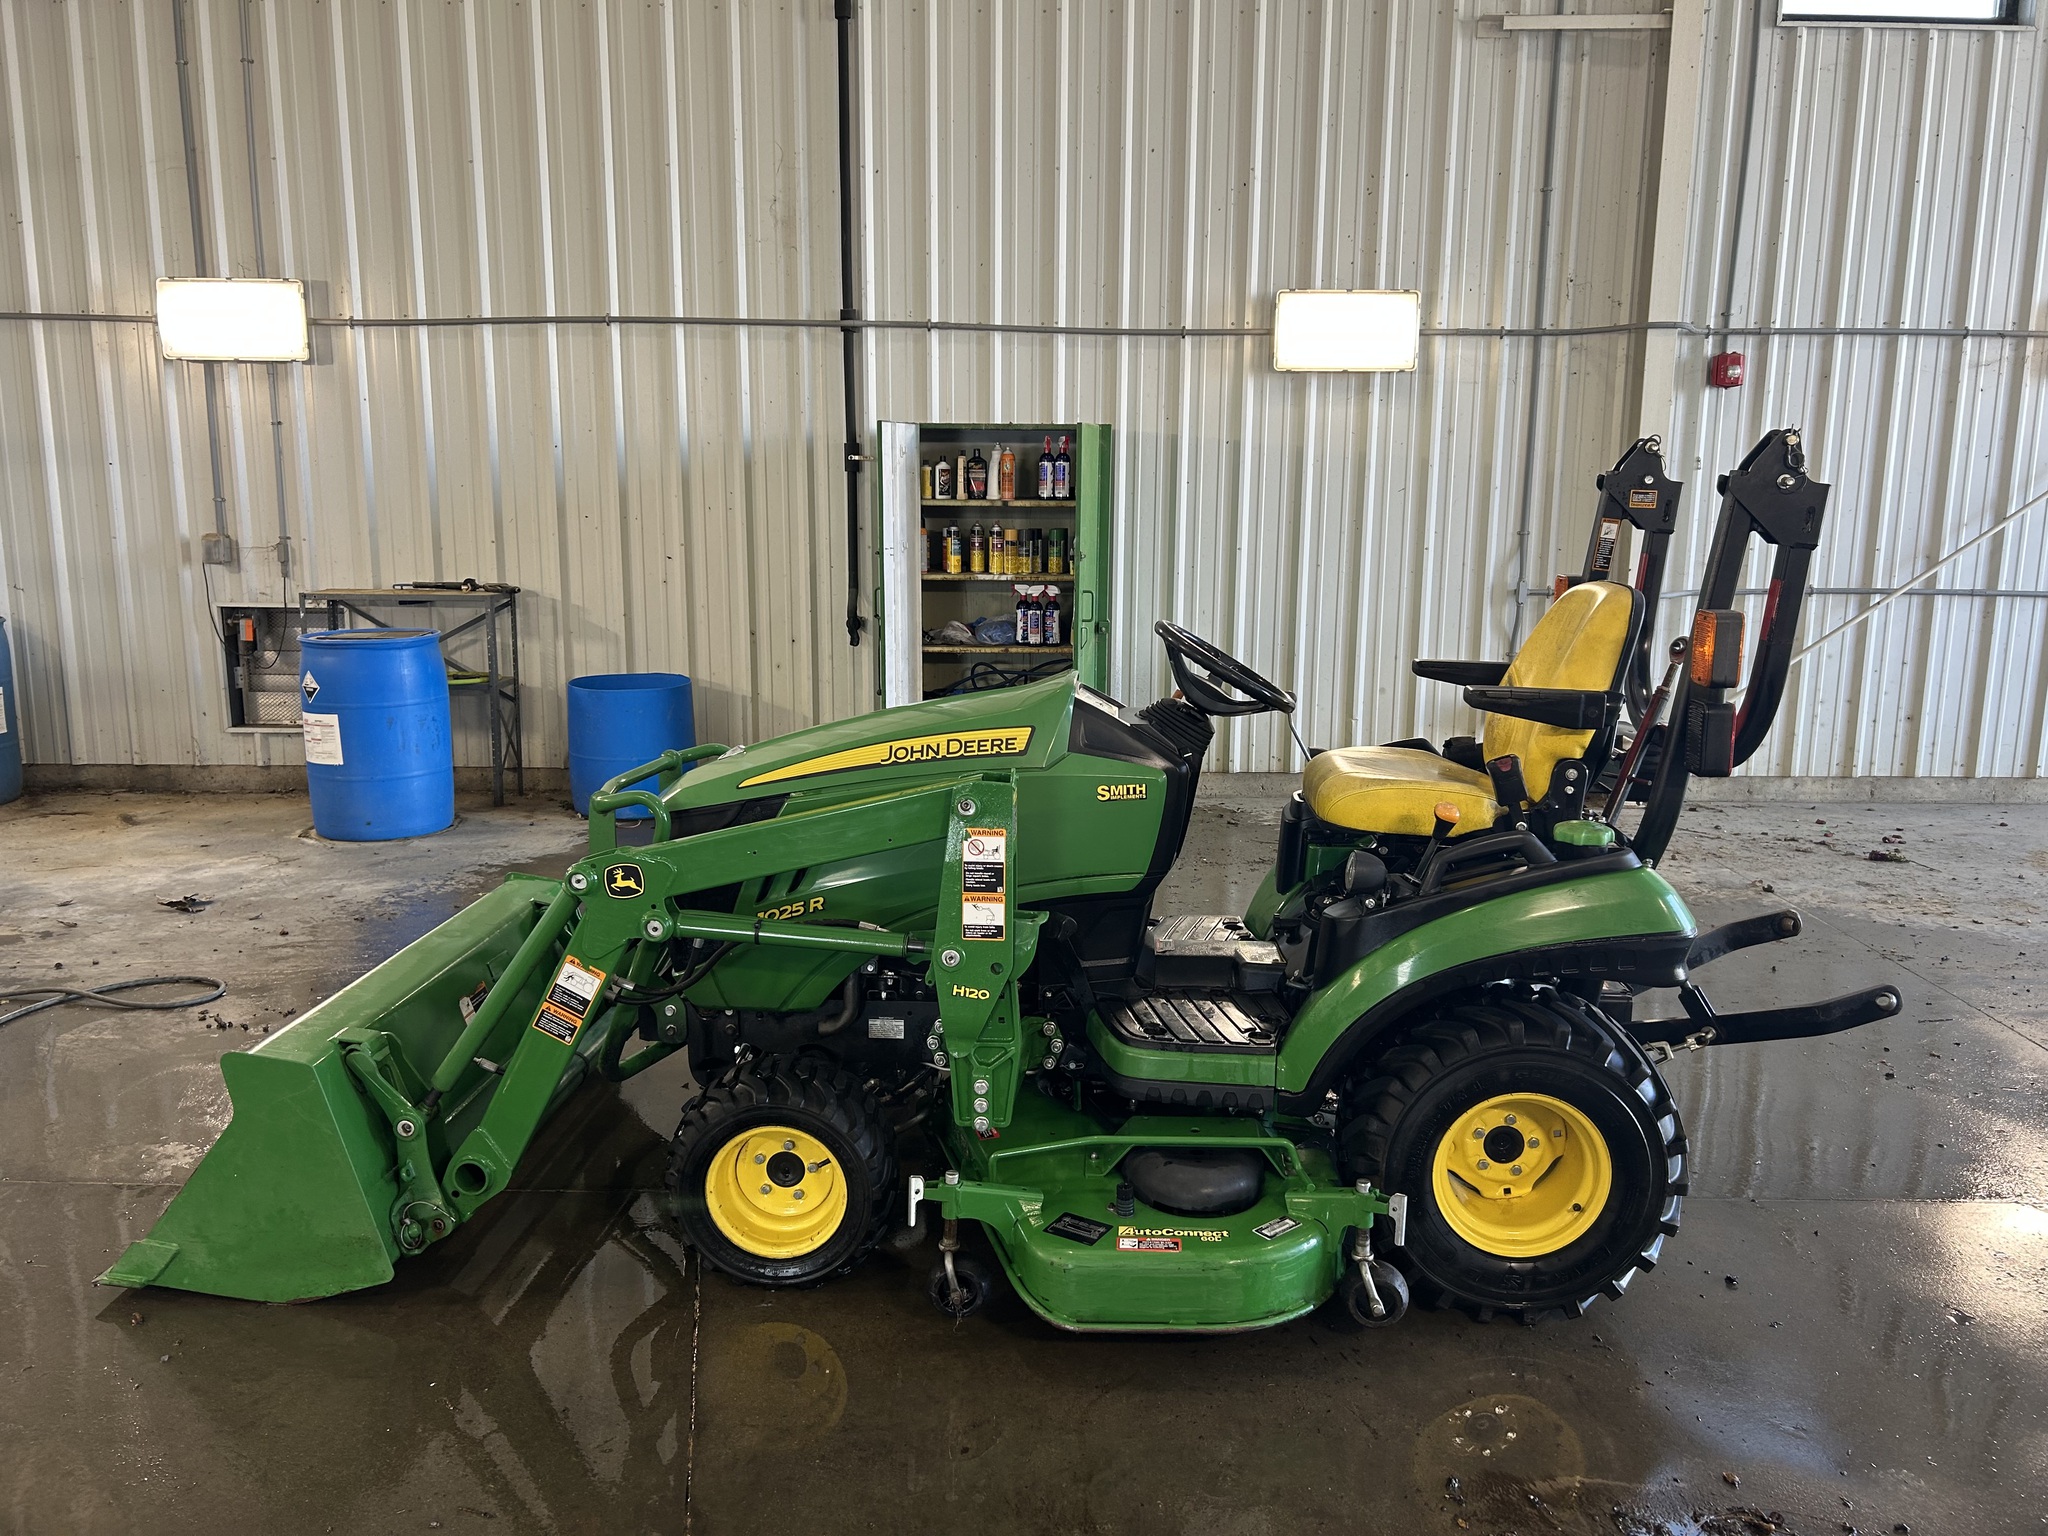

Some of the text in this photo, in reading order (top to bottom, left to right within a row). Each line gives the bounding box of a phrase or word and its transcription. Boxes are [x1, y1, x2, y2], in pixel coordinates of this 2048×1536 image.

[880, 737, 1018, 763] JOHN DEERE
[1096, 783, 1147, 801] SMITH
[970, 829, 1004, 837] WARNING
[809, 896, 825, 913] R
[970, 895, 1004, 903] WARNING
[952, 984, 990, 1000] H120
[553, 1008, 578, 1025] WARNING
[1119, 1226, 1229, 1238] AutoConnect
